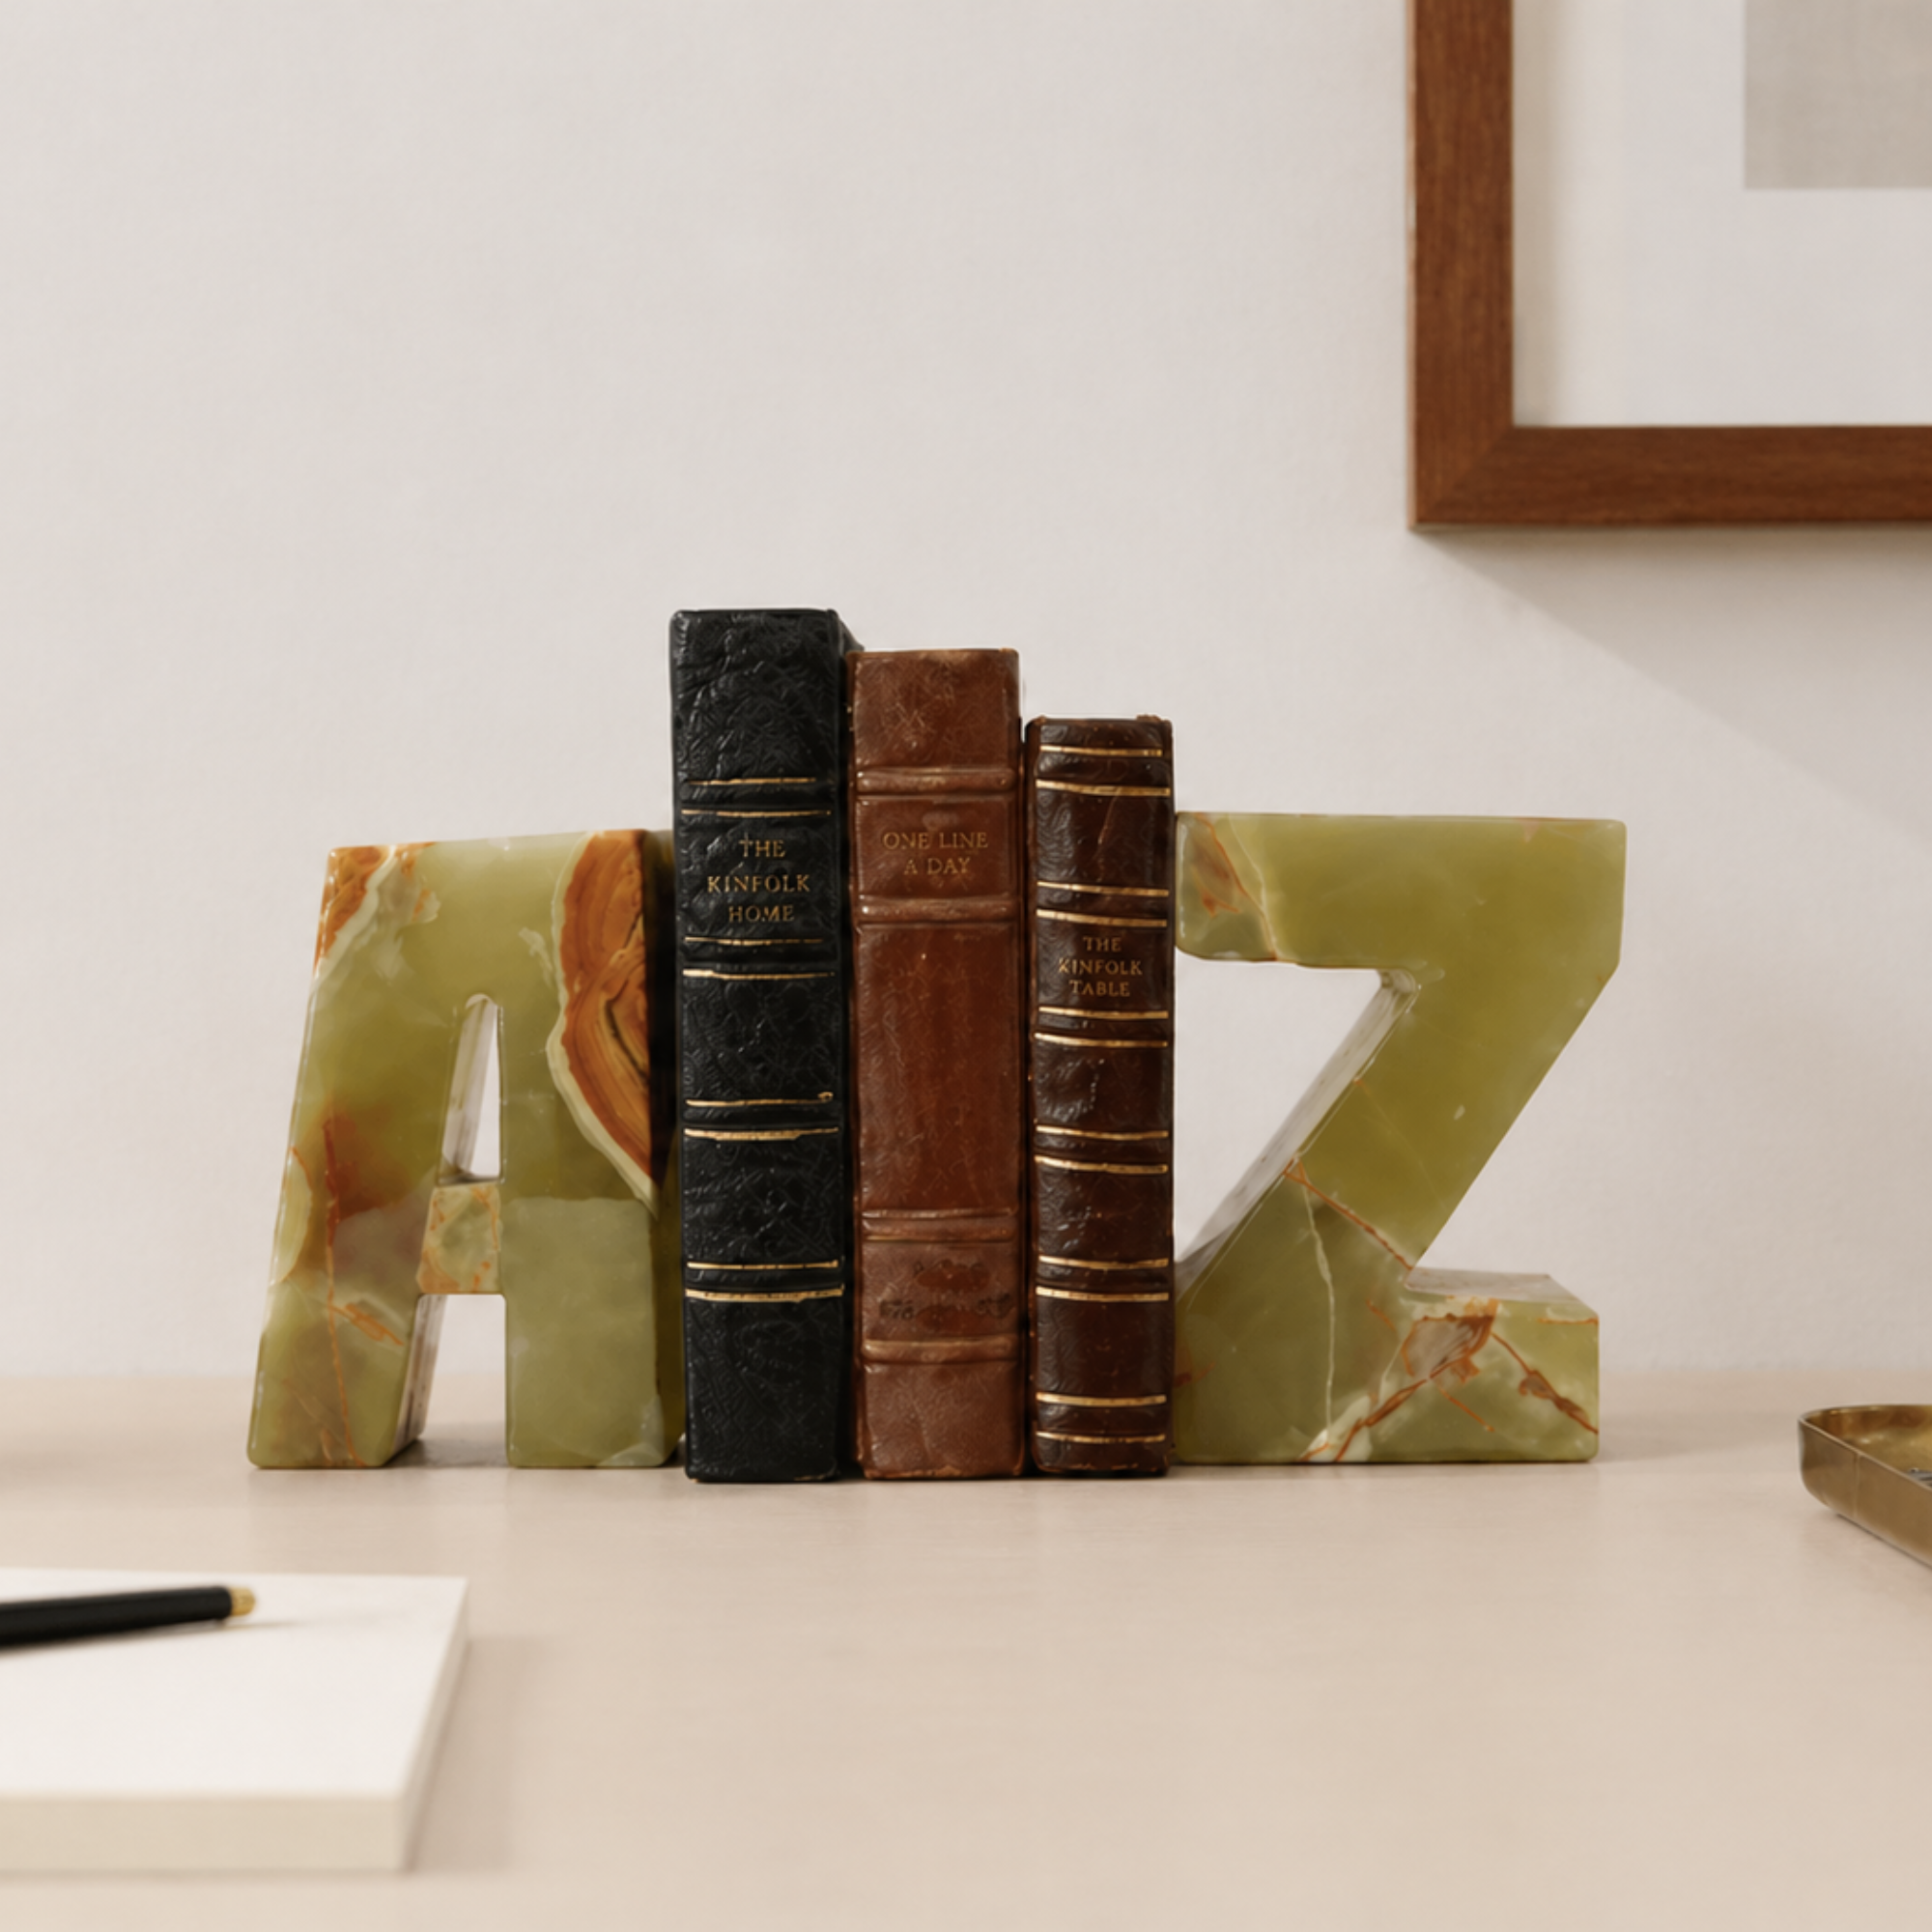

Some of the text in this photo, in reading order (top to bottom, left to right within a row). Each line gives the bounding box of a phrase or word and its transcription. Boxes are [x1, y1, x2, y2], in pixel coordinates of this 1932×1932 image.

[738, 835, 786, 858] THE
[882, 832, 988, 849] ONE LINE
[903, 857, 971, 875] A DAY
[706, 874, 810, 894] KINFOLK
[728, 905, 795, 923] HOME
[1083, 936, 1122, 952] THE
[1059, 957, 1144, 976] KINFOLK
[1068, 980, 1131, 998] TABLE
[1175, 812, 1627, 1463] Z
[248, 829, 681, 1467] A
